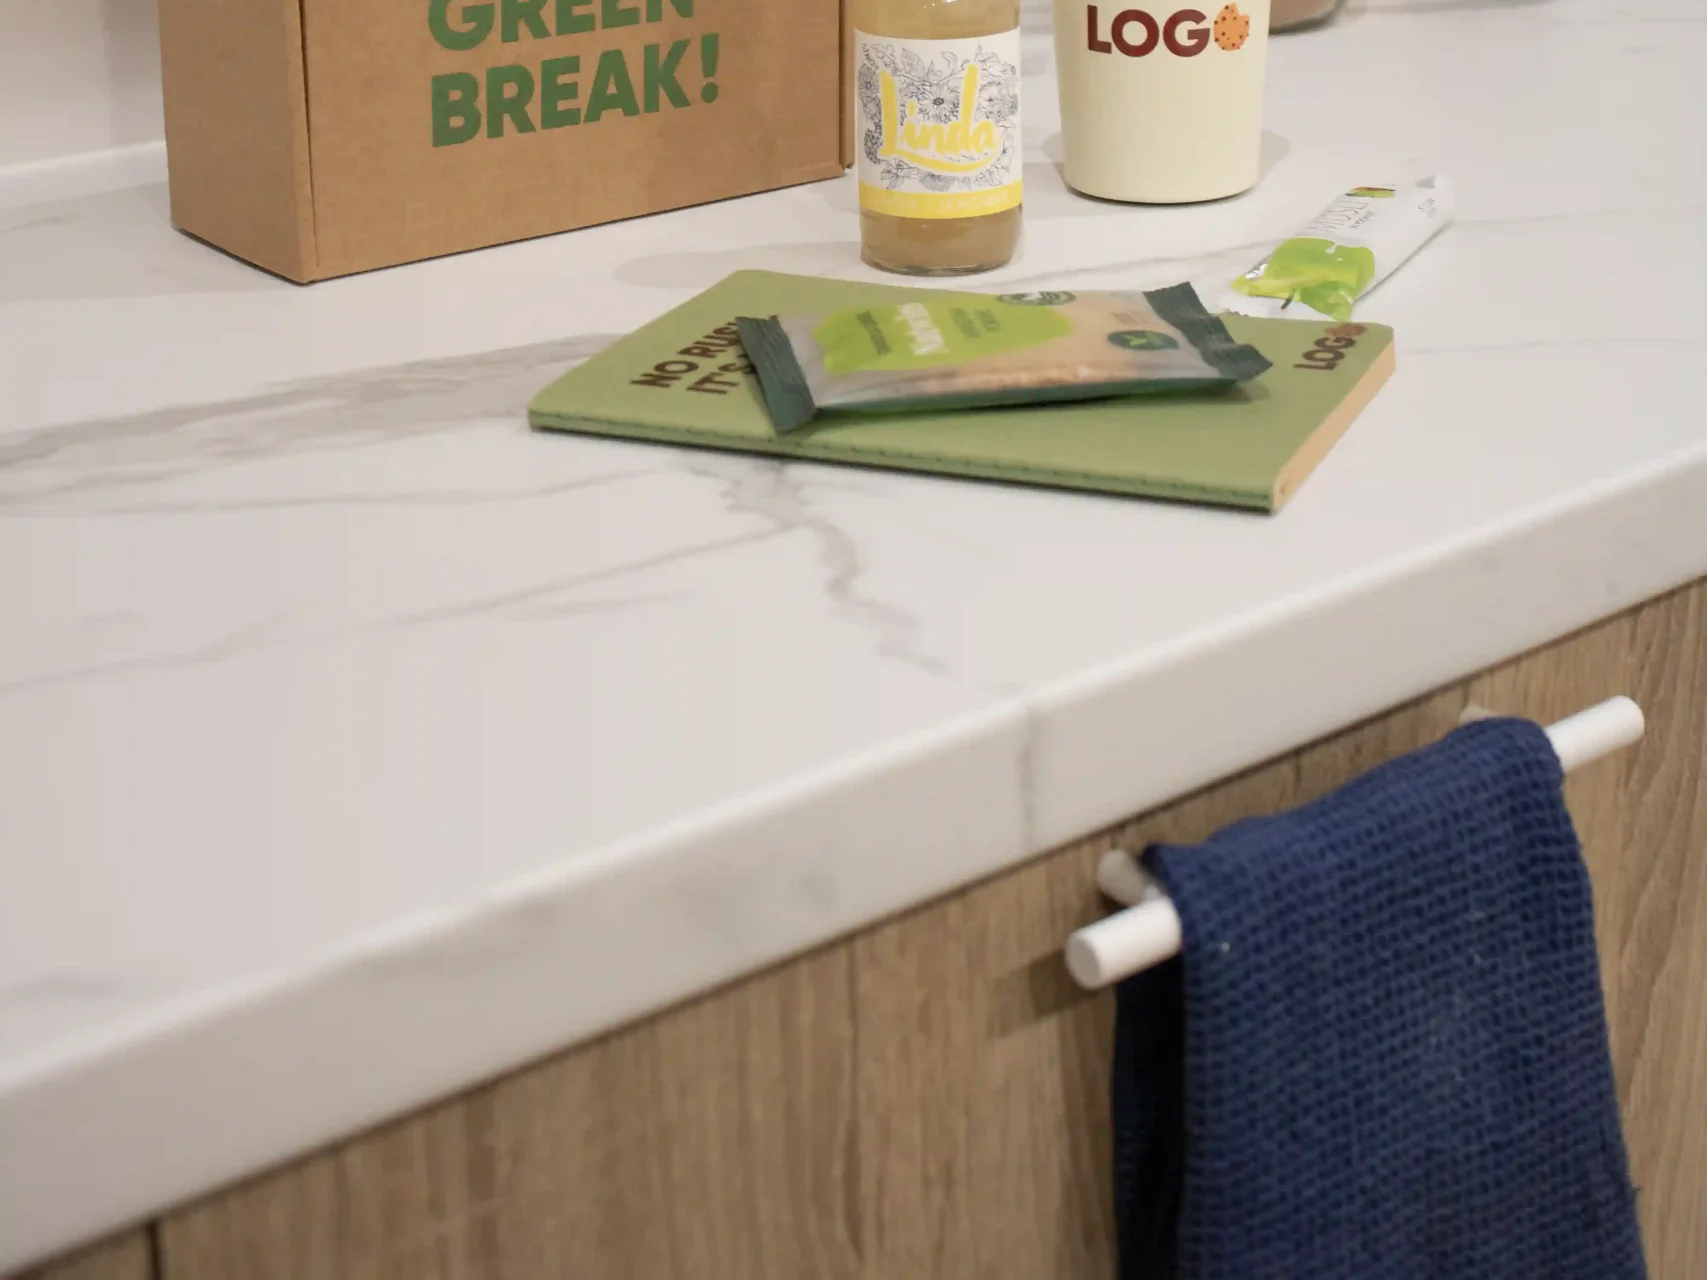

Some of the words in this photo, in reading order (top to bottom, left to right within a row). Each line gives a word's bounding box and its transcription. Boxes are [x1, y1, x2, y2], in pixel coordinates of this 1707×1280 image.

[431, 32, 719, 148] BREAK!
[878, 63, 998, 172] Linda
[630, 360, 699, 388] NO
[677, 322, 740, 358] RUS
